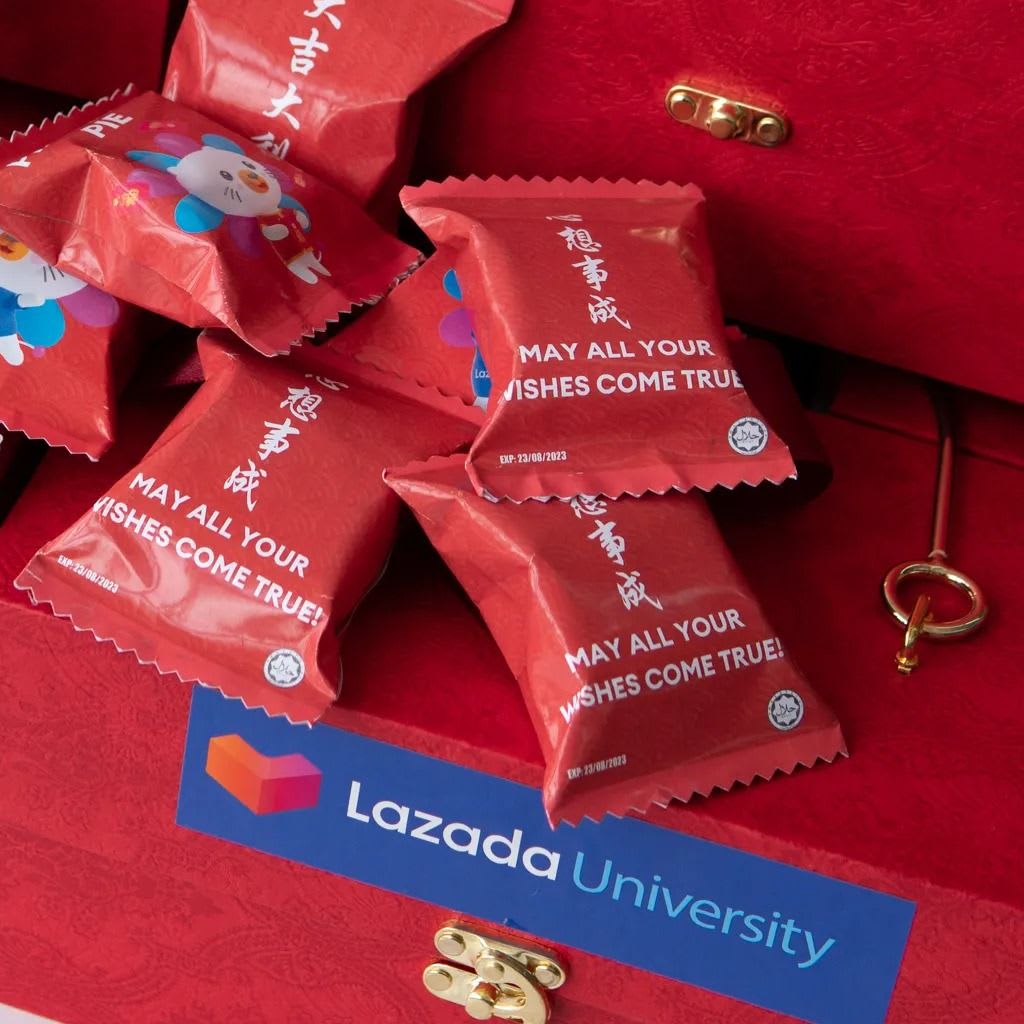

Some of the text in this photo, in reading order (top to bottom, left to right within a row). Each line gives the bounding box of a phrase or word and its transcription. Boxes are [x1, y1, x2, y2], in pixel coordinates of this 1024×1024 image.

[80, 112, 134, 139] PIE
[518, 339, 715, 364] MAY ALL YOUR
[596, 370, 676, 395] COME
[499, 450, 567, 464] EXP: 23/08/2023
[128, 472, 310, 578] MAY ALL YOUR
[175, 536, 252, 590] COME
[253, 574, 324, 626] TRUE!
[564, 608, 746, 673] MAY ALL YOUR
[644, 654, 716, 691] COME
[717, 637, 785, 672] TRUE!
[346, 780, 836, 969] Lazada University
